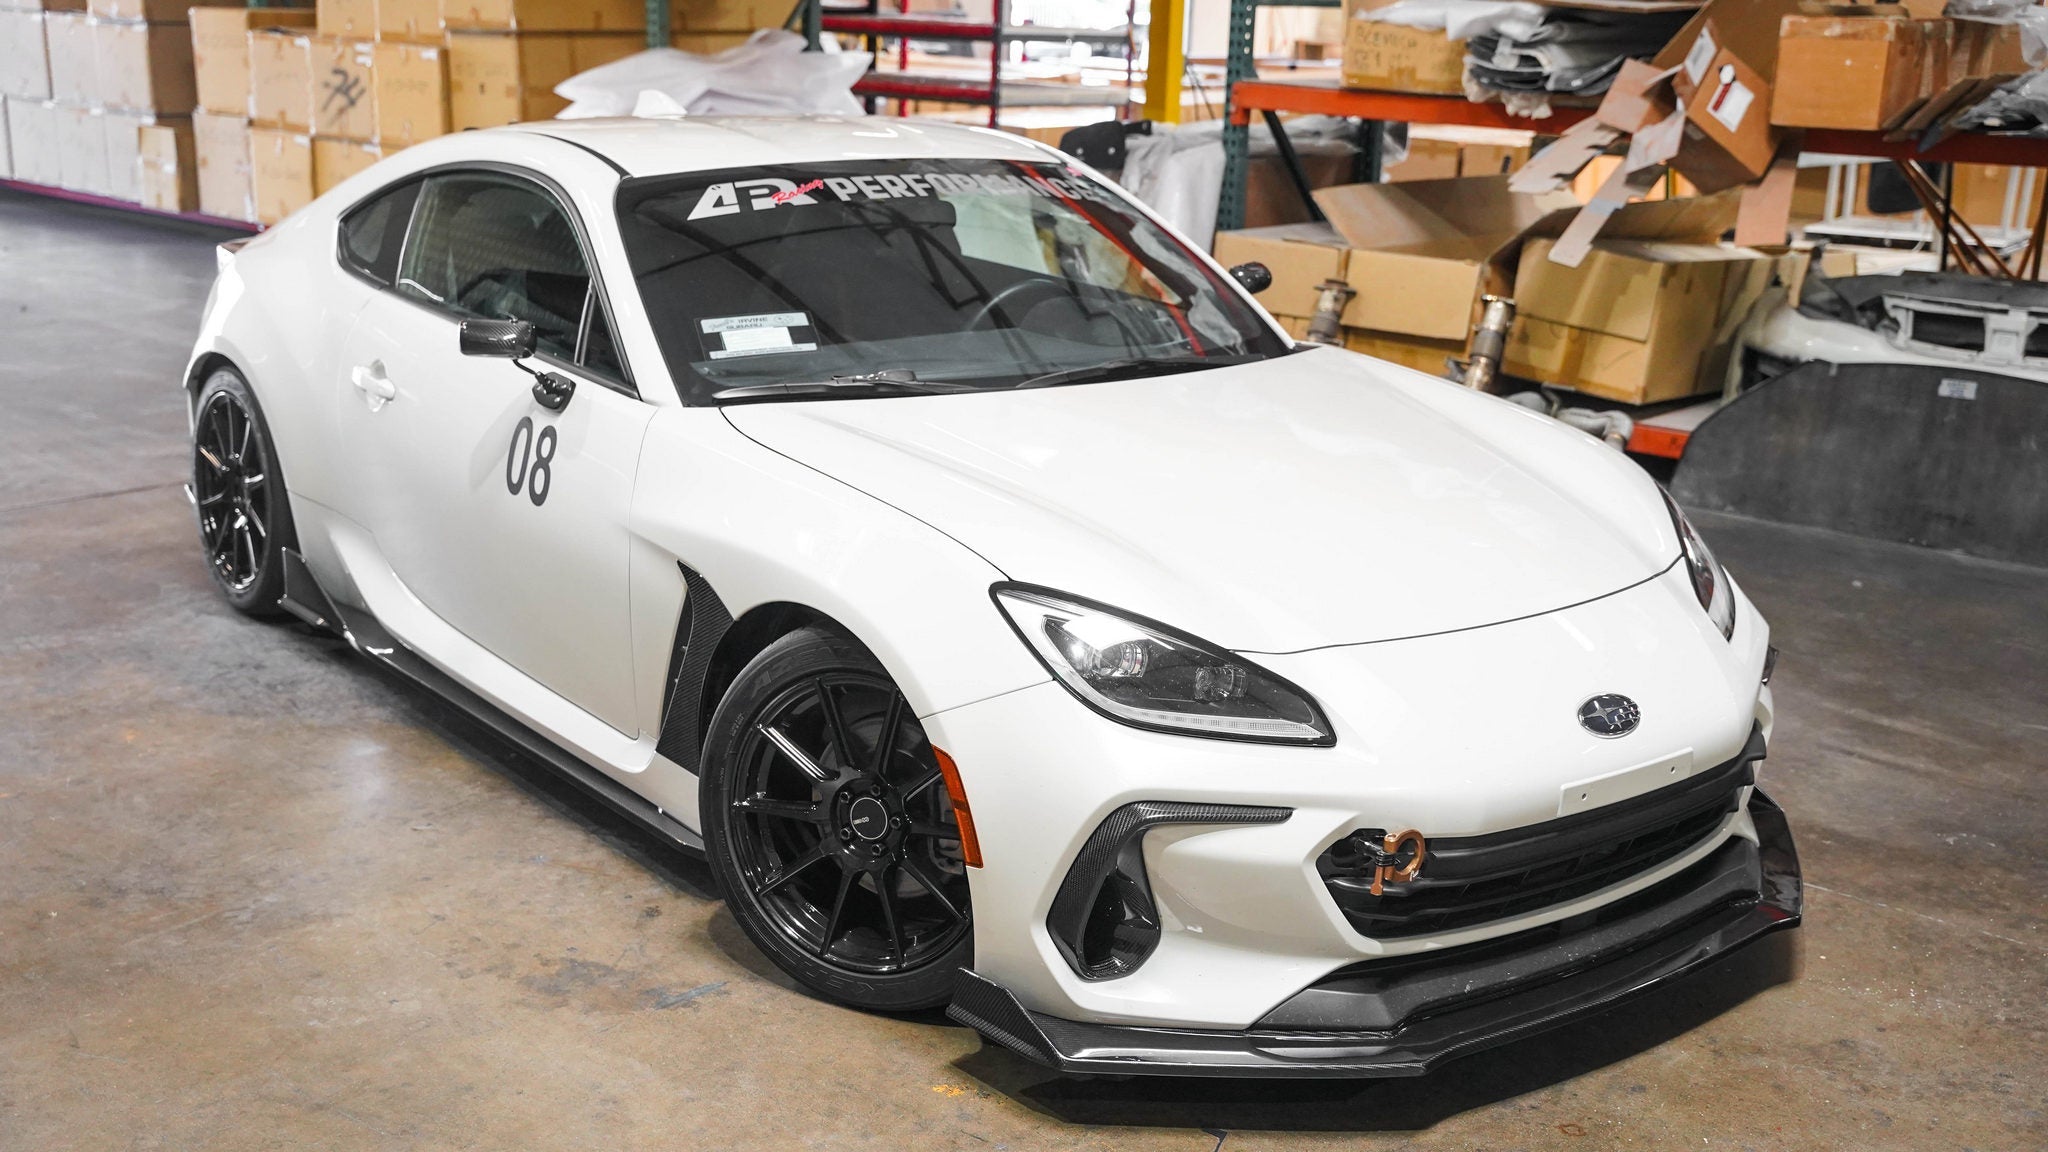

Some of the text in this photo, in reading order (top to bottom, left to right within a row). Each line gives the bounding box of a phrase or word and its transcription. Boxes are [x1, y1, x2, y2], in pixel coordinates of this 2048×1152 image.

[823, 172, 1097, 202] PERFORMANCE
[737, 316, 768, 324] IRVINE
[506, 416, 557, 507] 08
